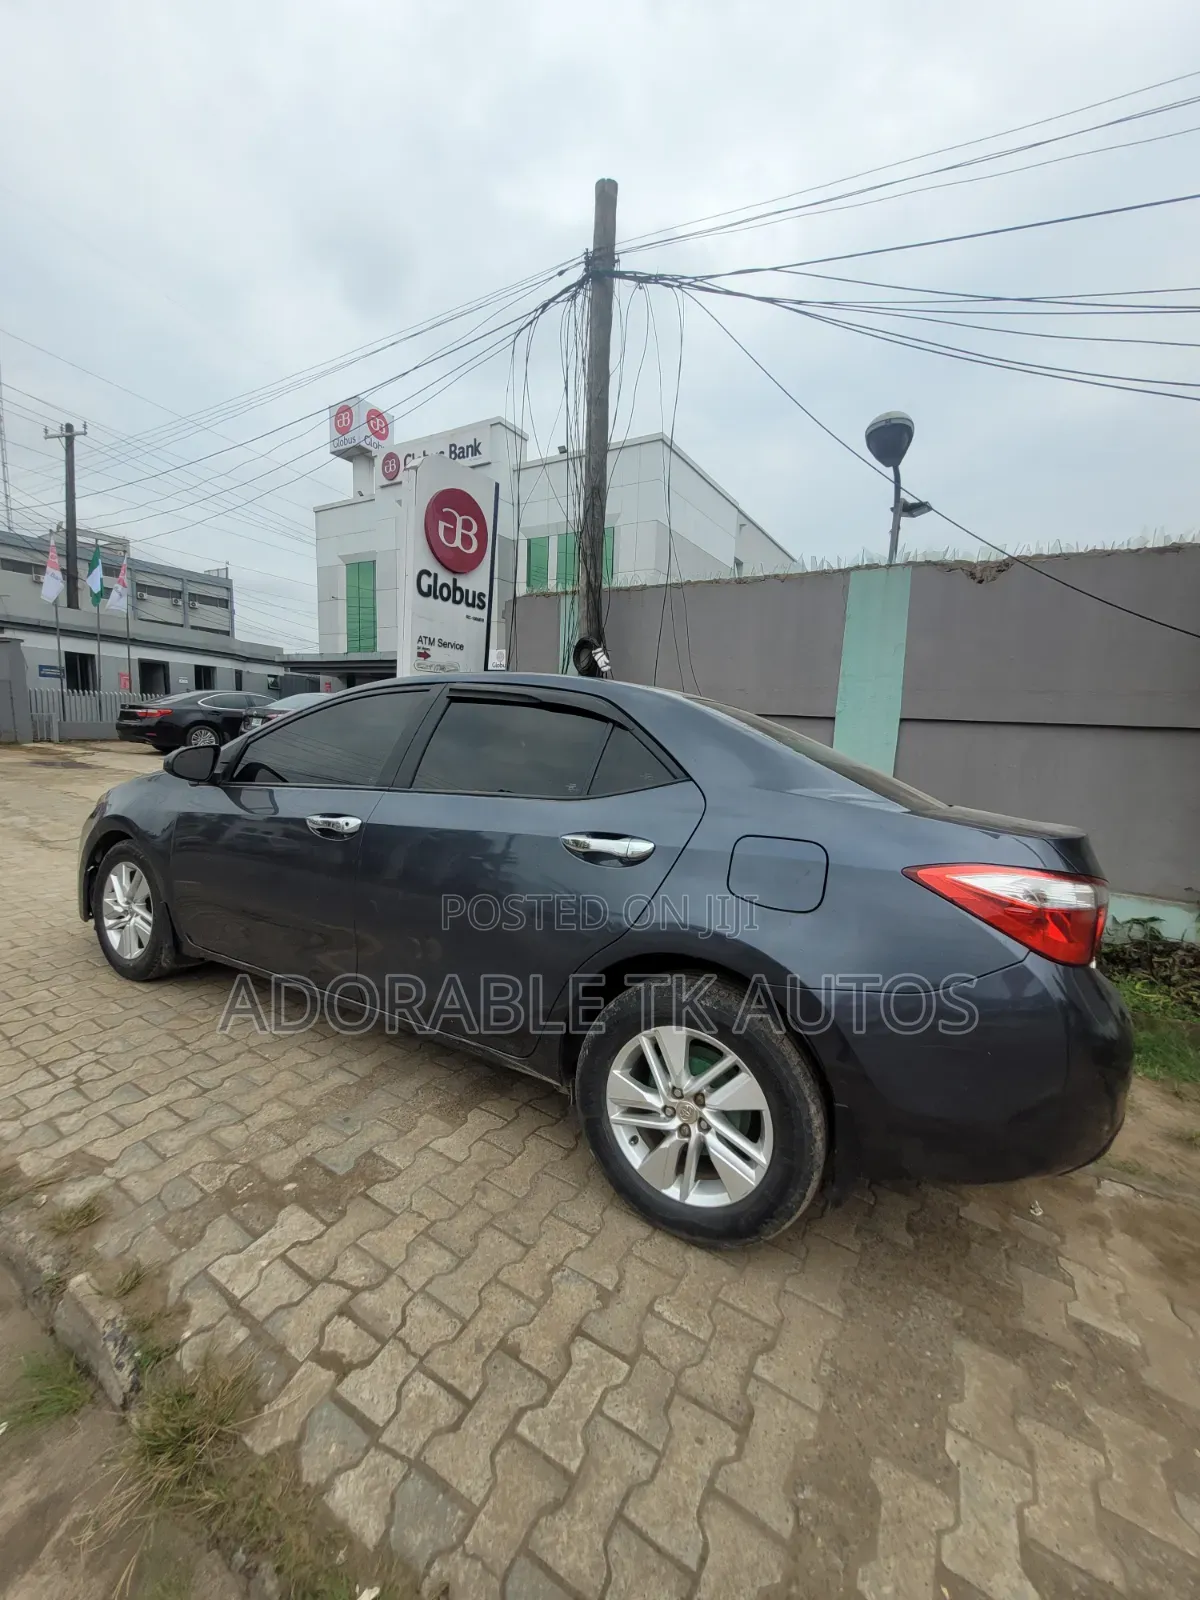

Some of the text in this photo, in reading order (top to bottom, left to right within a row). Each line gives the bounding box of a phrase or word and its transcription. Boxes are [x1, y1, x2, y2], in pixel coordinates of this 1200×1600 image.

[448, 438, 482, 461] Bank
[416, 568, 486, 610] Globus
[416, 635, 436, 647] ATM
[437, 638, 465, 651] Service
